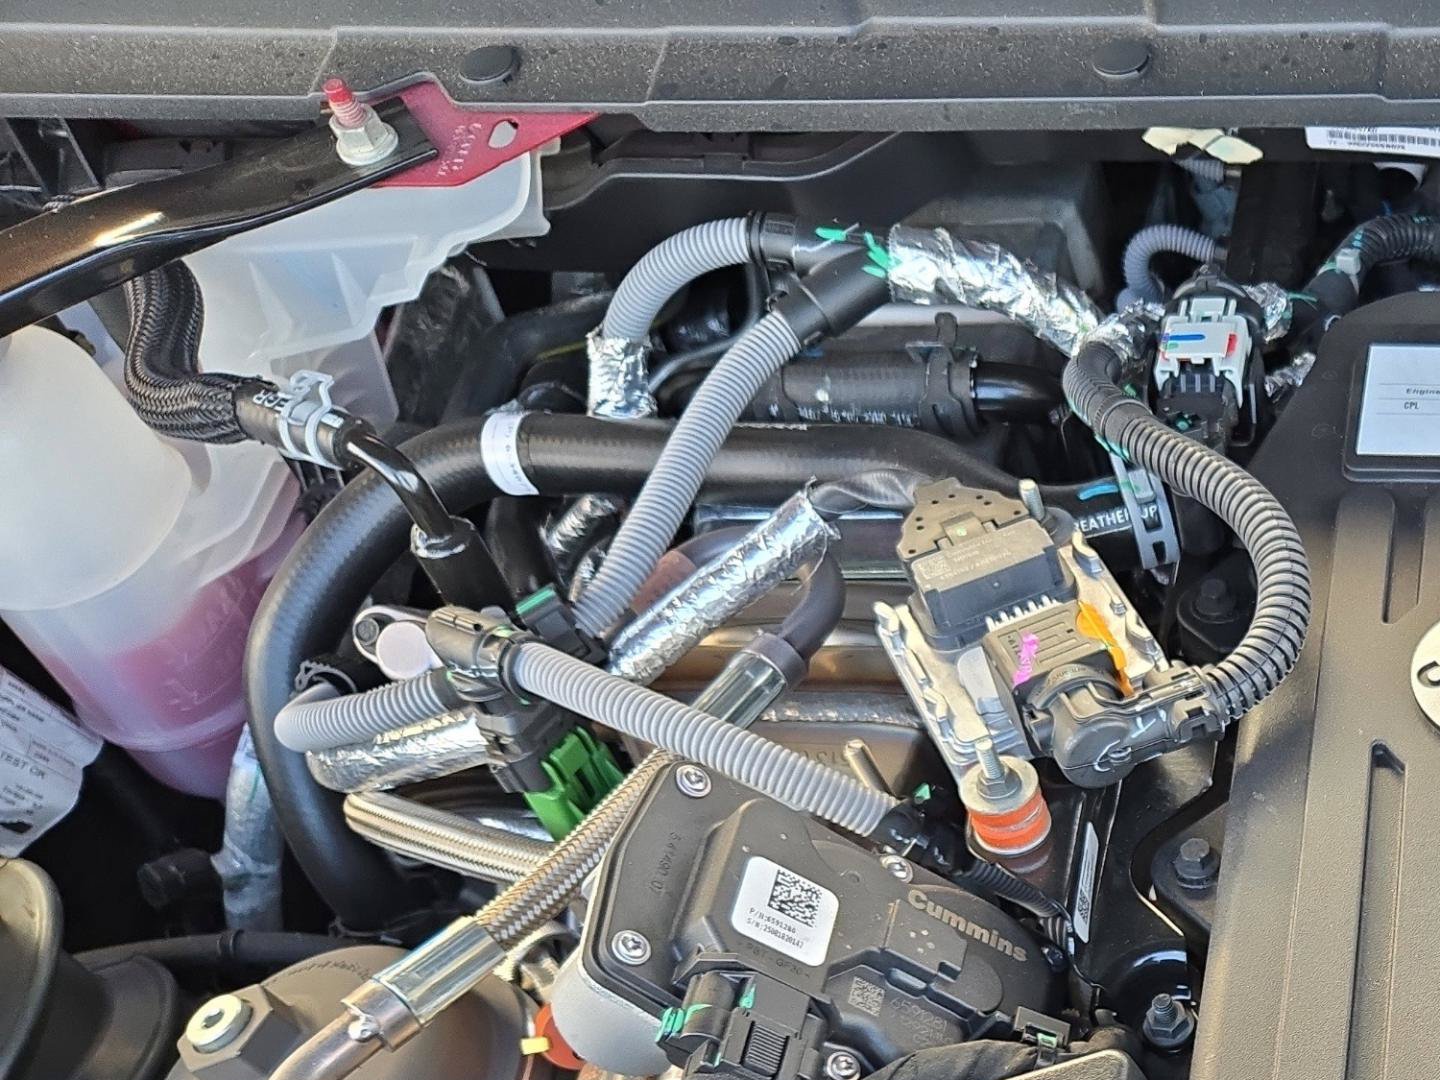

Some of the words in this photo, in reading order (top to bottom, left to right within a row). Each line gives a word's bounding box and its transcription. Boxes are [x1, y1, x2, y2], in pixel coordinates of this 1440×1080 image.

[1406, 388, 1440, 396] Engine
[1403, 401, 1420, 409] CPL
[907, 889, 1028, 962] Cummins
